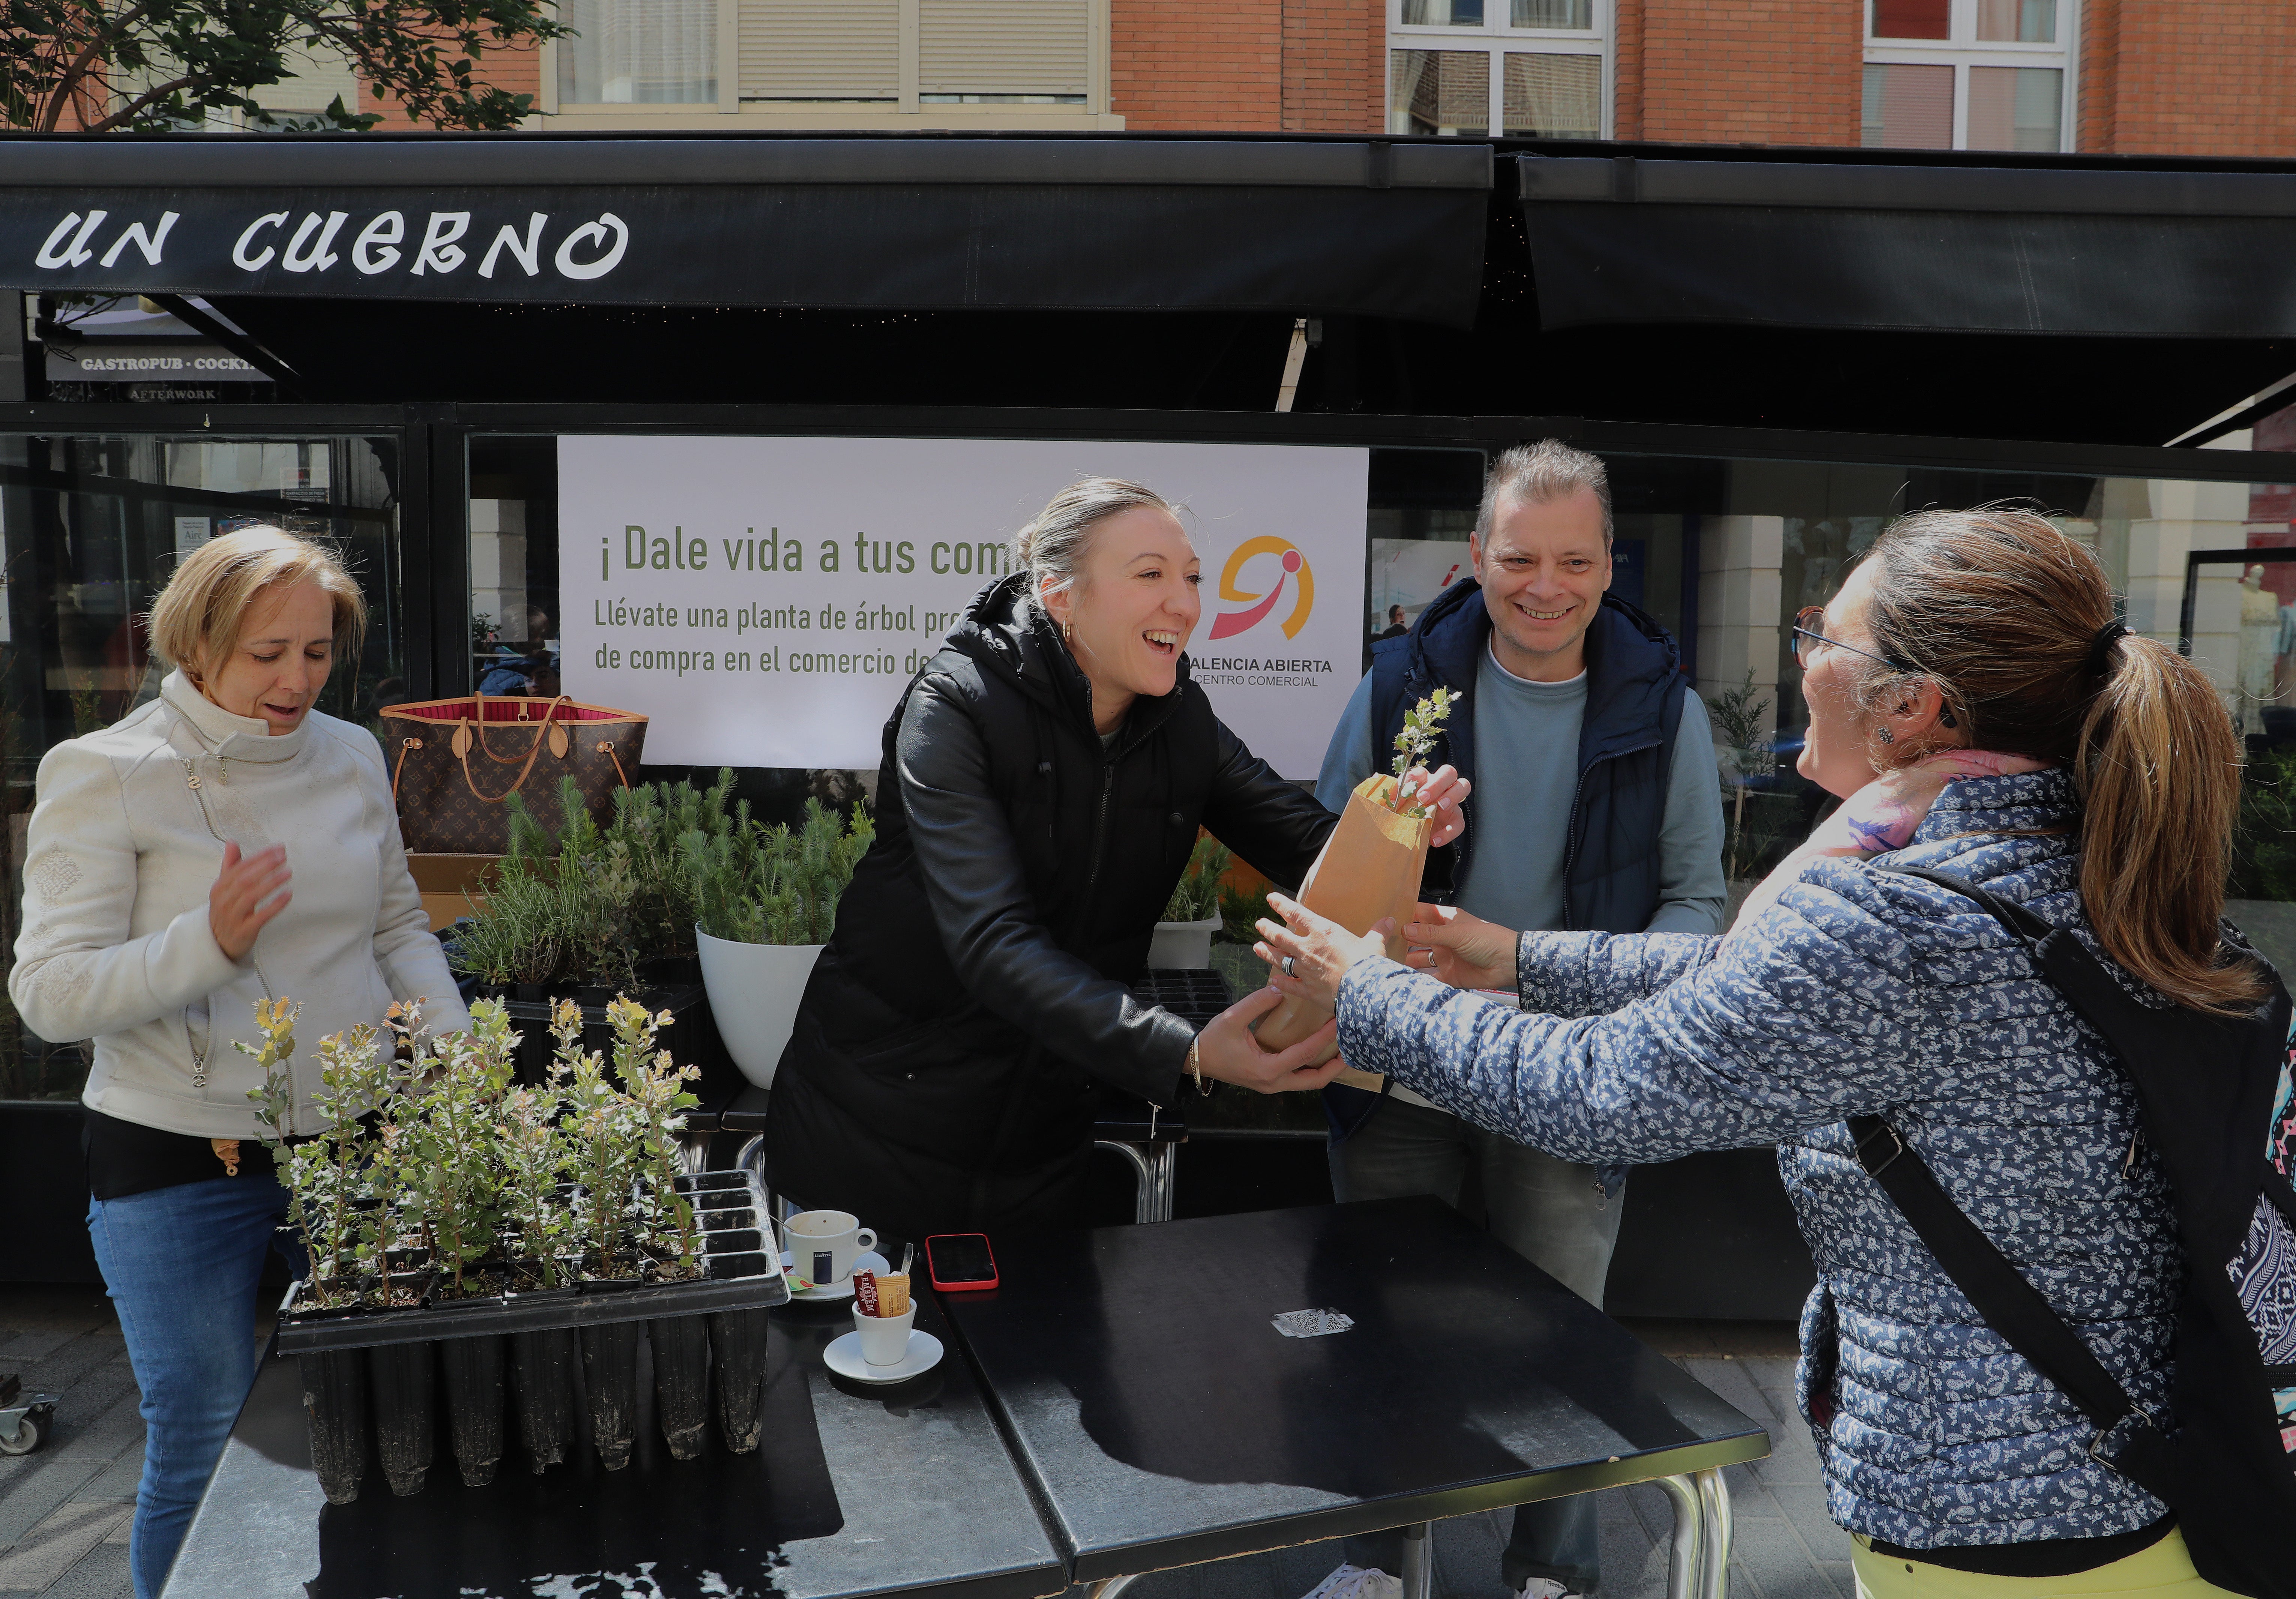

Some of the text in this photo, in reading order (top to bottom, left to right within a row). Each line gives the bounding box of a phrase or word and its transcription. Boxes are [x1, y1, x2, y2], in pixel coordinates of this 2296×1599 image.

[35, 210, 628, 280] UN CUERNO
[82, 358, 255, 370] GASTROPUB COCKT
[131, 390, 215, 399] AFTERWORK
[625, 525, 707, 570] Dale
[722, 527, 802, 572] vida
[820, 540, 839, 572] a
[854, 532, 915, 574] tus
[931, 542, 1020, 575] com
[1613, 554, 1629, 562] AXA
[595, 597, 677, 627] Llévate
[687, 608, 728, 628] una
[738, 602, 810, 635] planta
[820, 603, 846, 630] de
[855, 601, 916, 631] árbol
[595, 643, 930, 677] de compra en el comercio de
[1190, 657, 1333, 673] ALENCIA ABIERTA
[1194, 674, 1318, 687] CENTRO COMERCIAL
[861, 1277, 874, 1311] EMBLEM
[1547, 1581, 1566, 1591] Reebok
